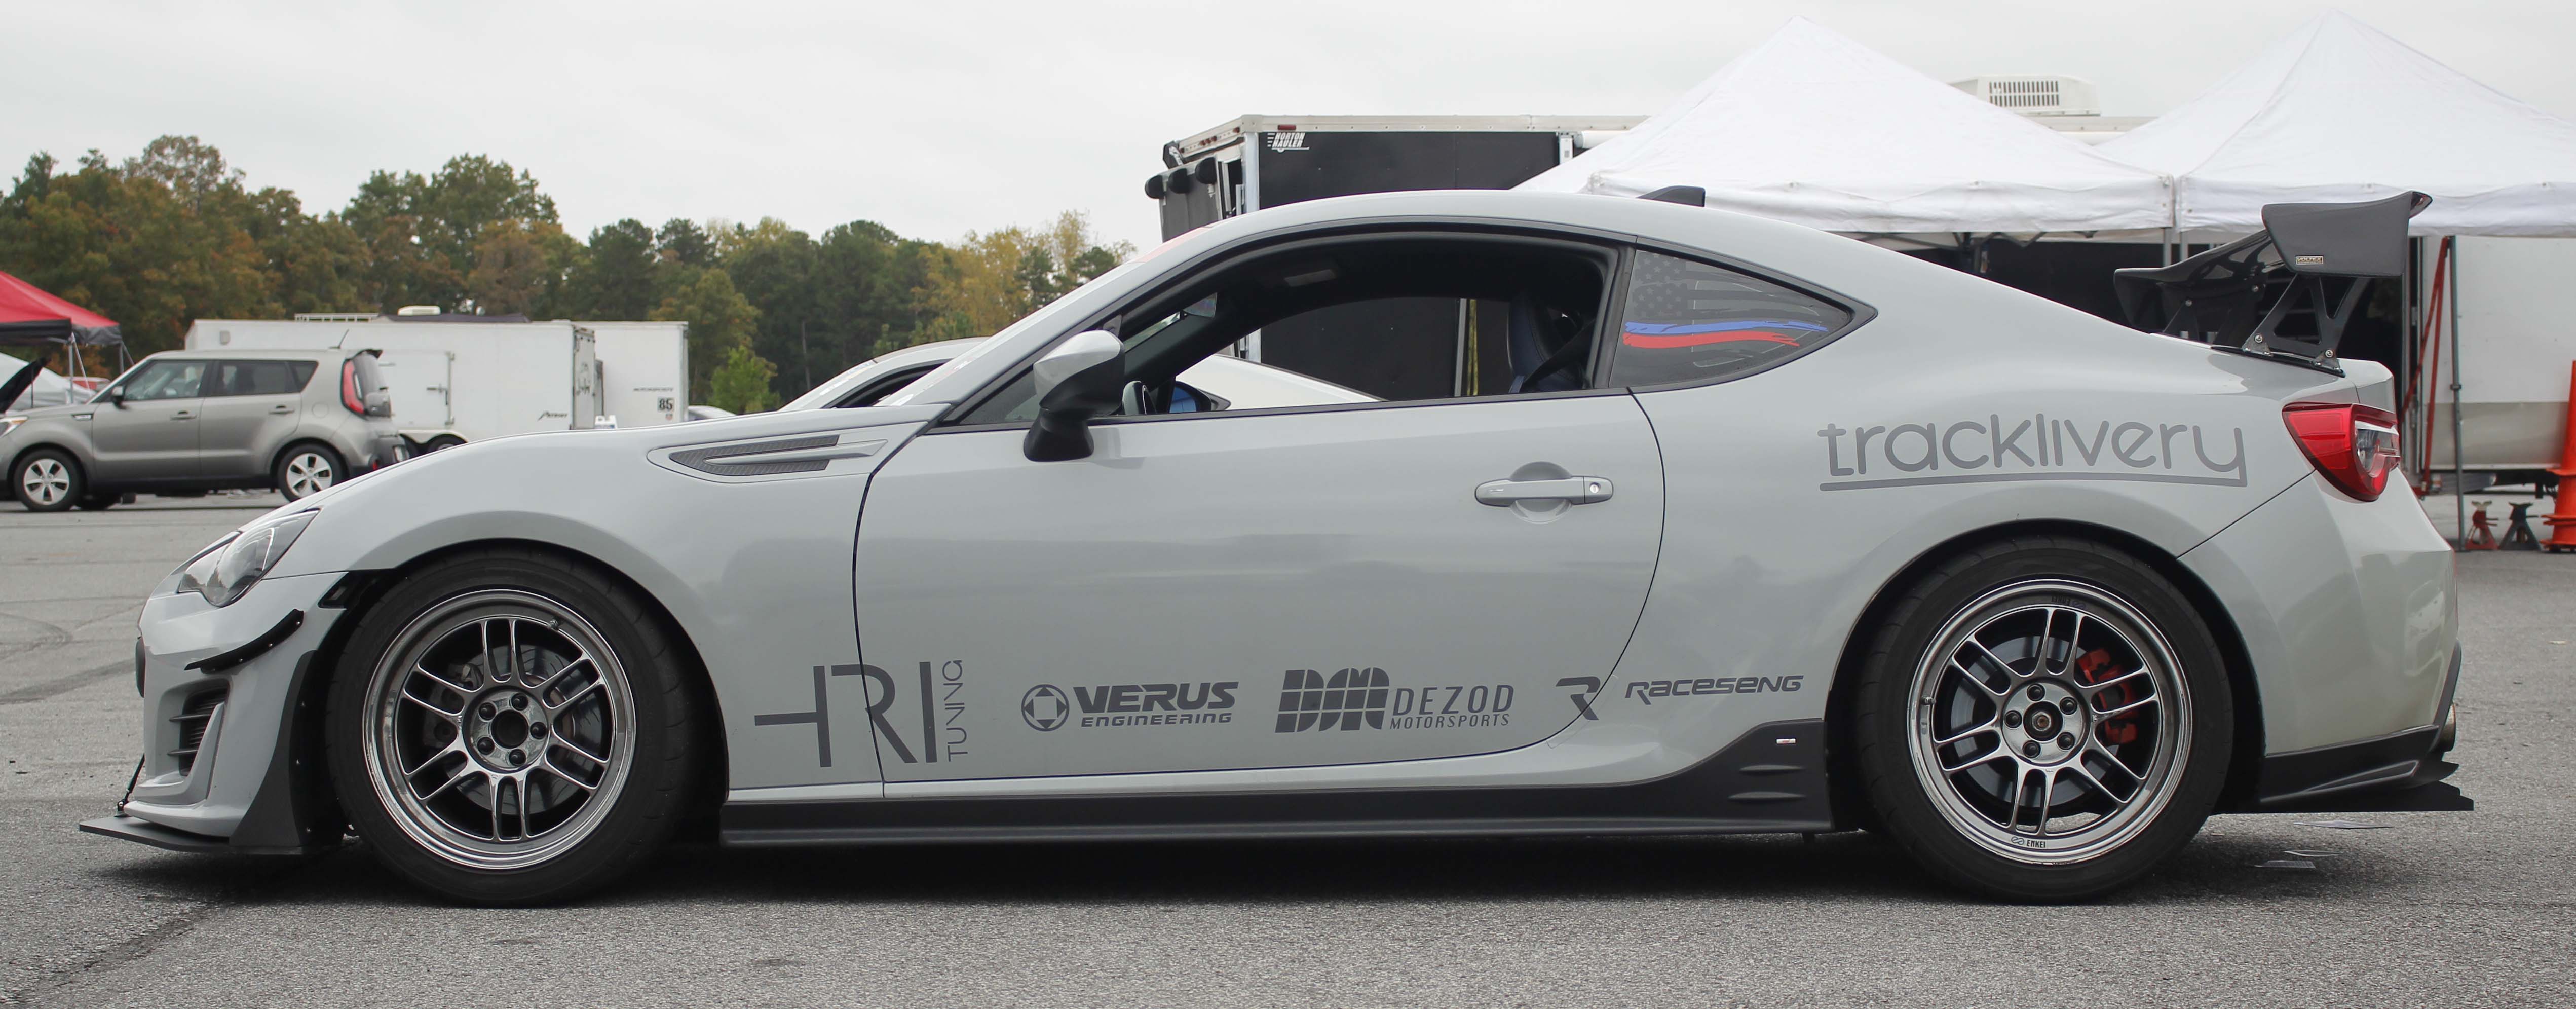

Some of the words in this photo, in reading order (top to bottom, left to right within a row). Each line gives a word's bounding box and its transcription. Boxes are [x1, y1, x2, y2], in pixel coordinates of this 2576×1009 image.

[659, 398, 673, 410] 85
[1817, 413, 2248, 491] tracklivery
[1073, 682, 1239, 714] VERUS
[1392, 685, 1514, 716] DEZOD
[942, 660, 968, 762] TUNING
[1081, 713, 1232, 727] ENGINEERING
[1390, 714, 1510, 730] MOTORSPORTS
[2027, 839, 2046, 848] ENKEI
